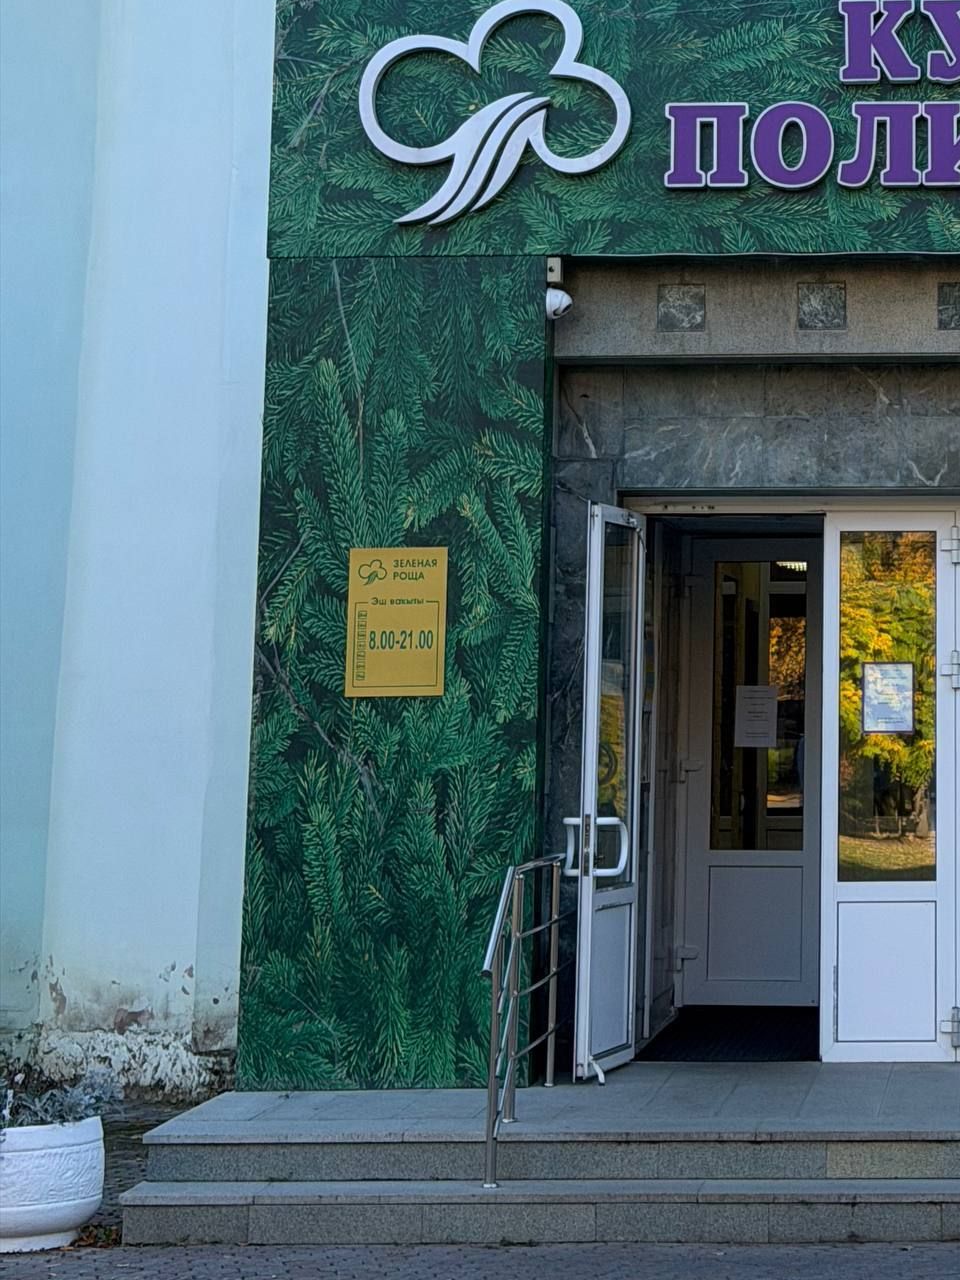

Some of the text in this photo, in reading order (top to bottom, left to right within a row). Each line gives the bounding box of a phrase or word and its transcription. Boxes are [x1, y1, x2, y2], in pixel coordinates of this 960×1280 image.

[393, 559, 438, 568] ЗЕЛЕНАЯ
[393, 572, 425, 581] РОЩА
[368, 630, 433, 650] 8.00-21.00
